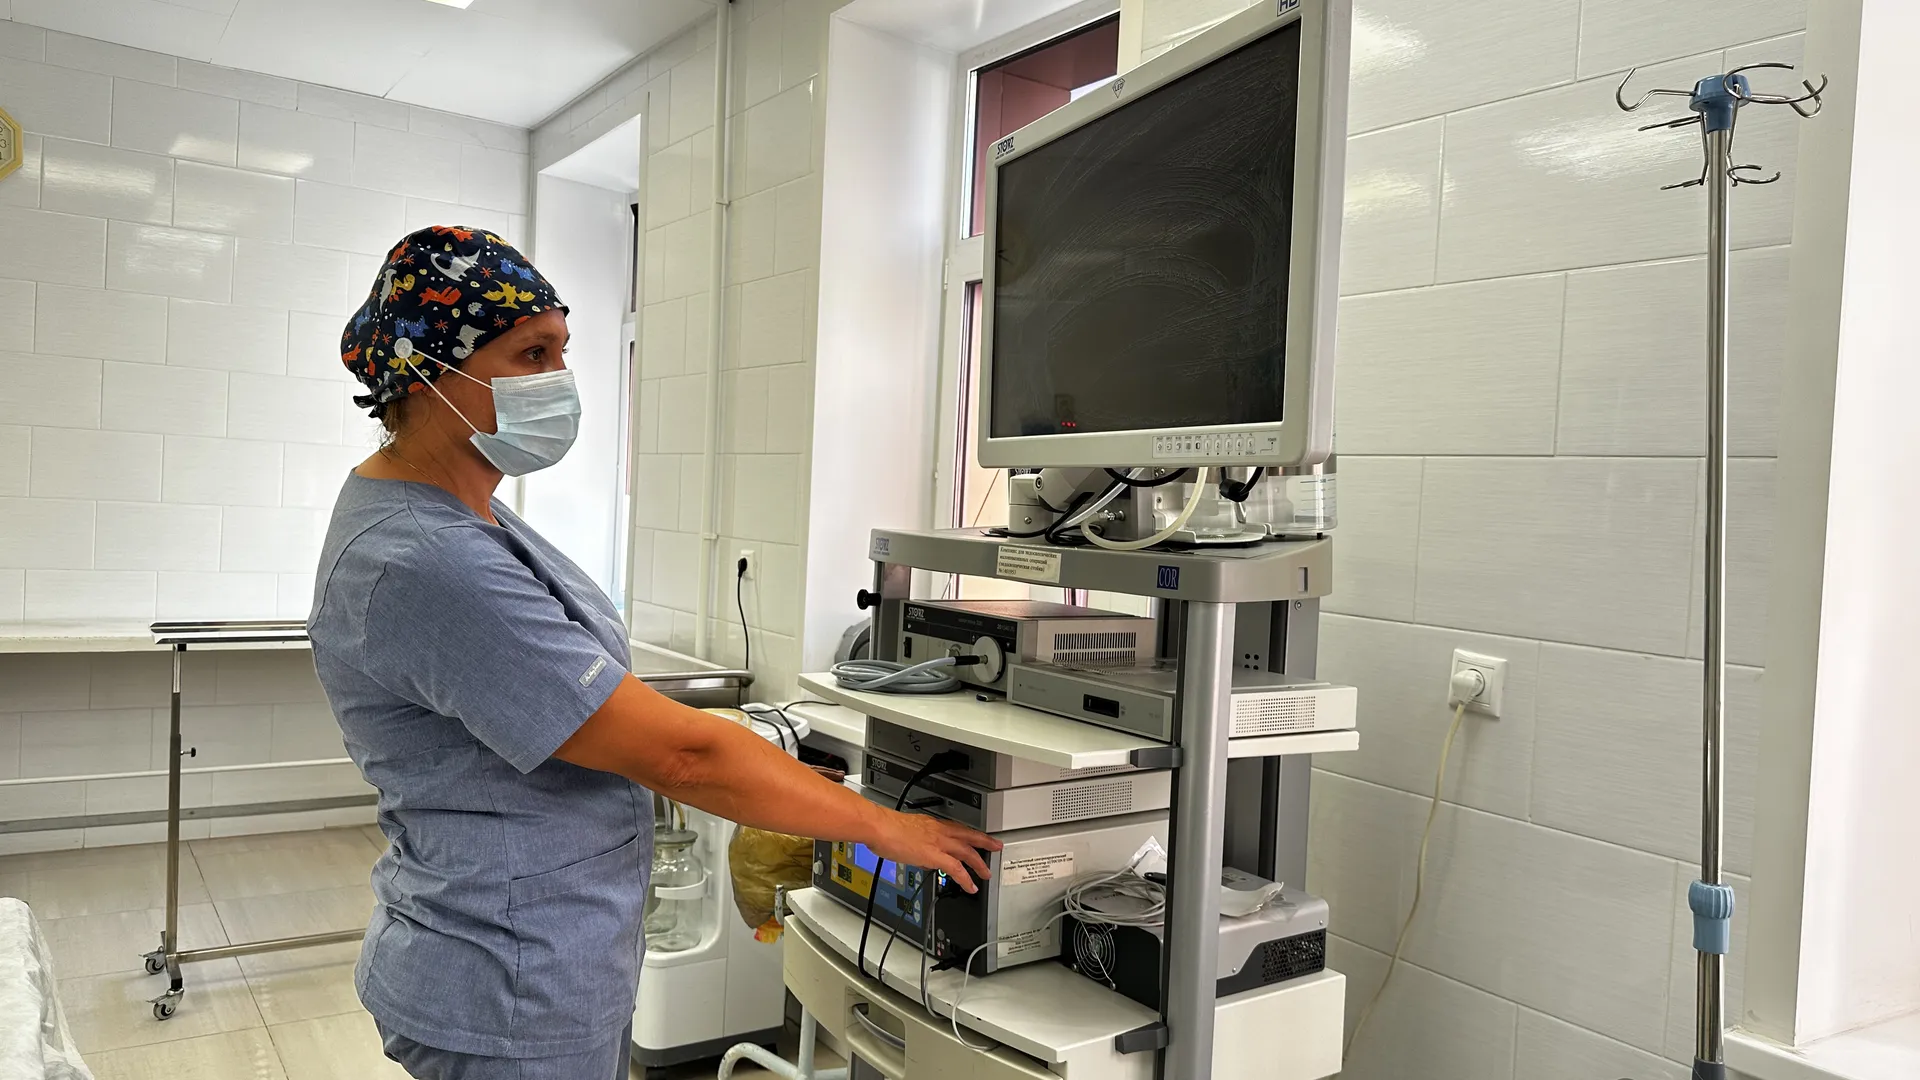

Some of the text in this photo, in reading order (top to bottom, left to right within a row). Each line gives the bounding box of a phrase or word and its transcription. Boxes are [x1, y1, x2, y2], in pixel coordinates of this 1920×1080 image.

[1279, 0, 1298, 12] HD
[997, 136, 1014, 155] STORZ
[1158, 567, 1178, 588] COR
[908, 606, 925, 618] STORZ
